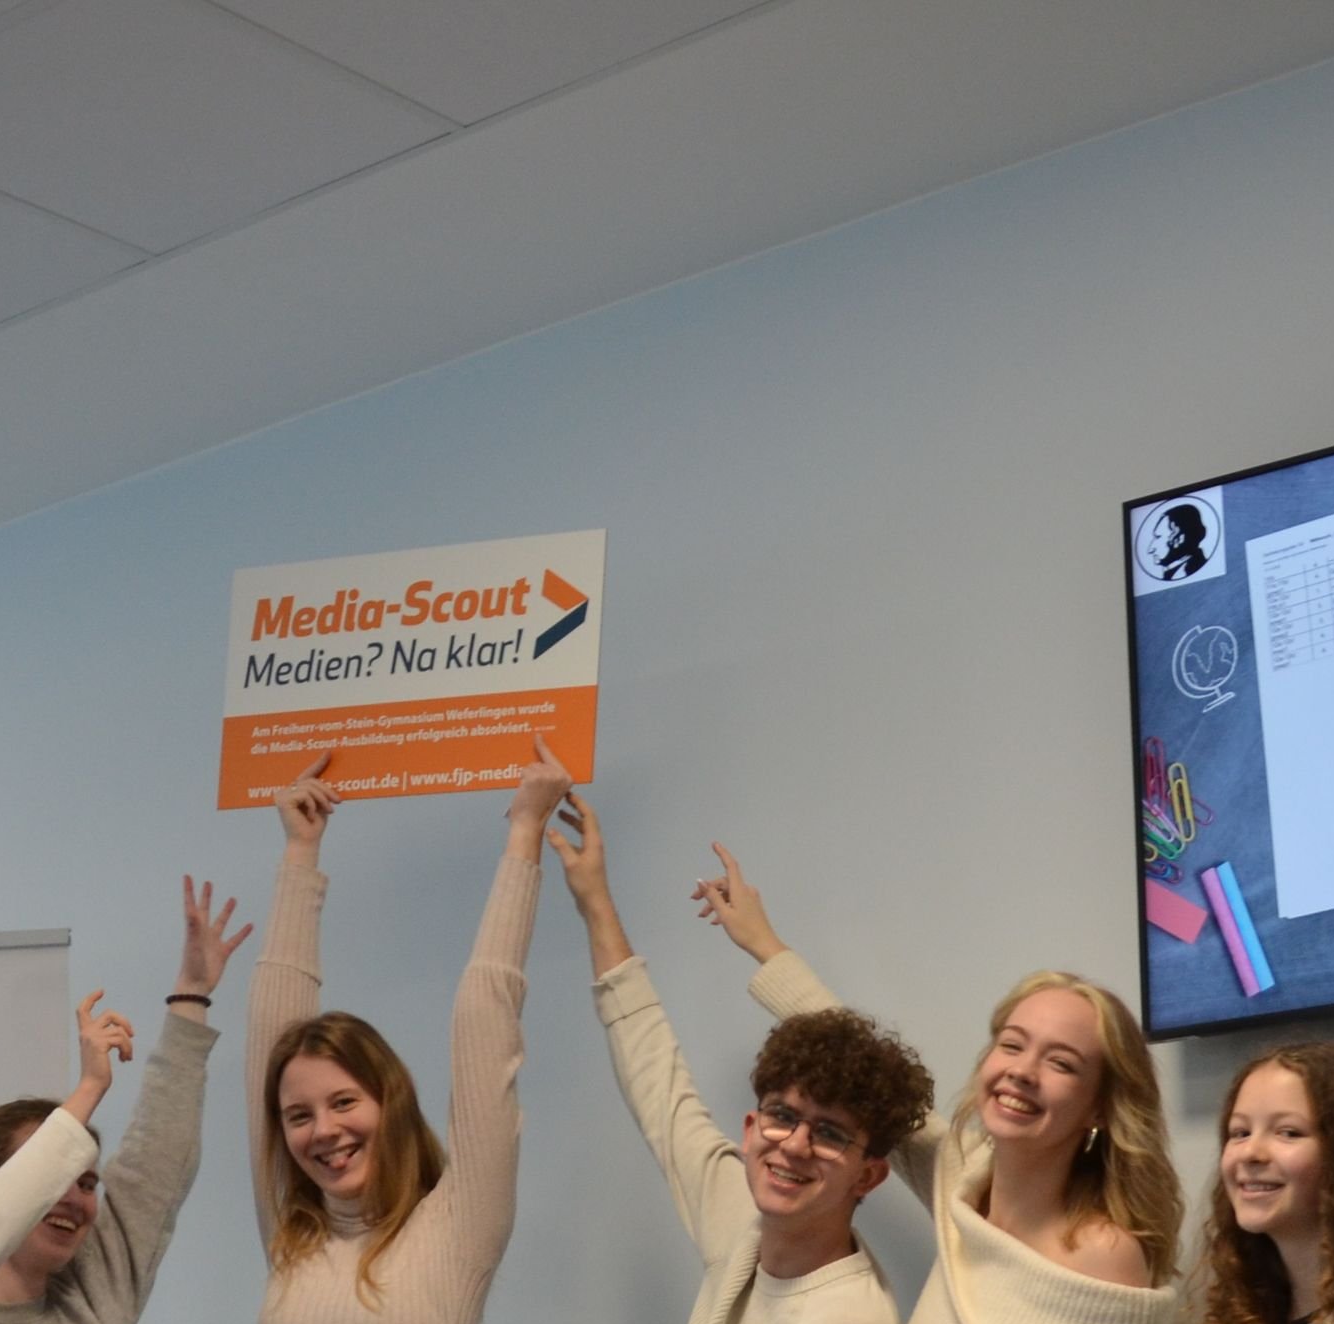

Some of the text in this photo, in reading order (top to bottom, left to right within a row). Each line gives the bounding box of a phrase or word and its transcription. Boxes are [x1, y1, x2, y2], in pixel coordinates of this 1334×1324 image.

[251, 576, 530, 641] Media-Scout
[243, 629, 524, 688] Medien? Na klar!
[251, 743, 268, 755] die
[406, 726, 468, 742] erfolgreich
[252, 726, 271, 738] Am
[518, 702, 556, 716] wurde
